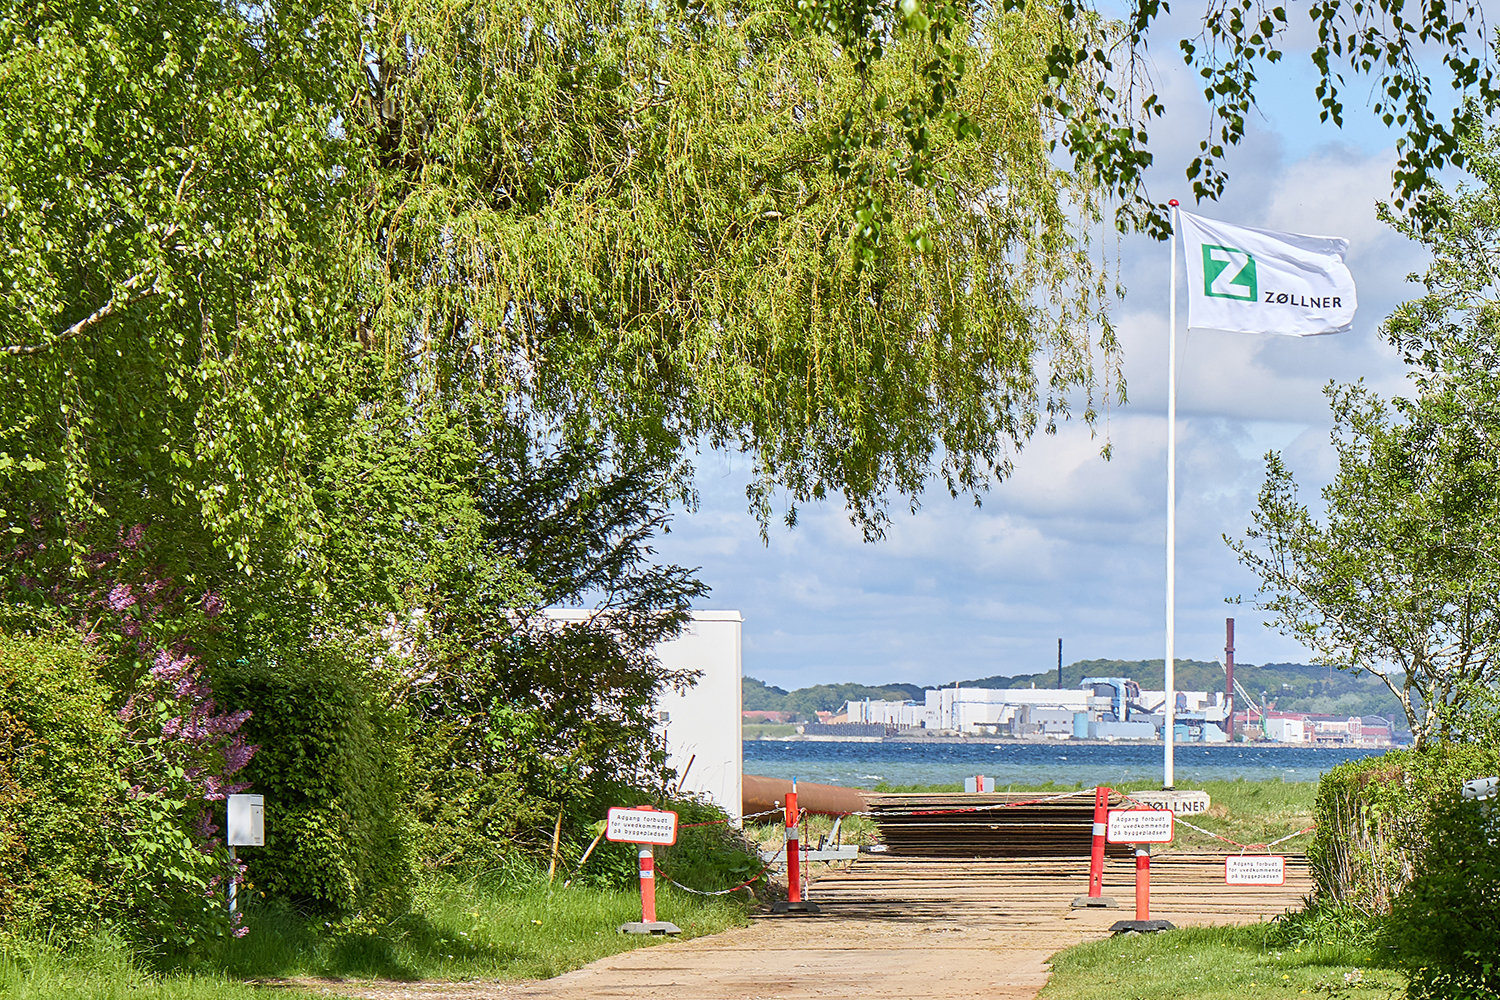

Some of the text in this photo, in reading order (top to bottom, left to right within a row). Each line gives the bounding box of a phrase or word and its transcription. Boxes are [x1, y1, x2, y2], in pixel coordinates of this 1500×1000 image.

[1210, 248, 1250, 297] Z
[1265, 291, 1342, 309] ZØLLNER
[624, 829, 669, 837] byggepladsen
